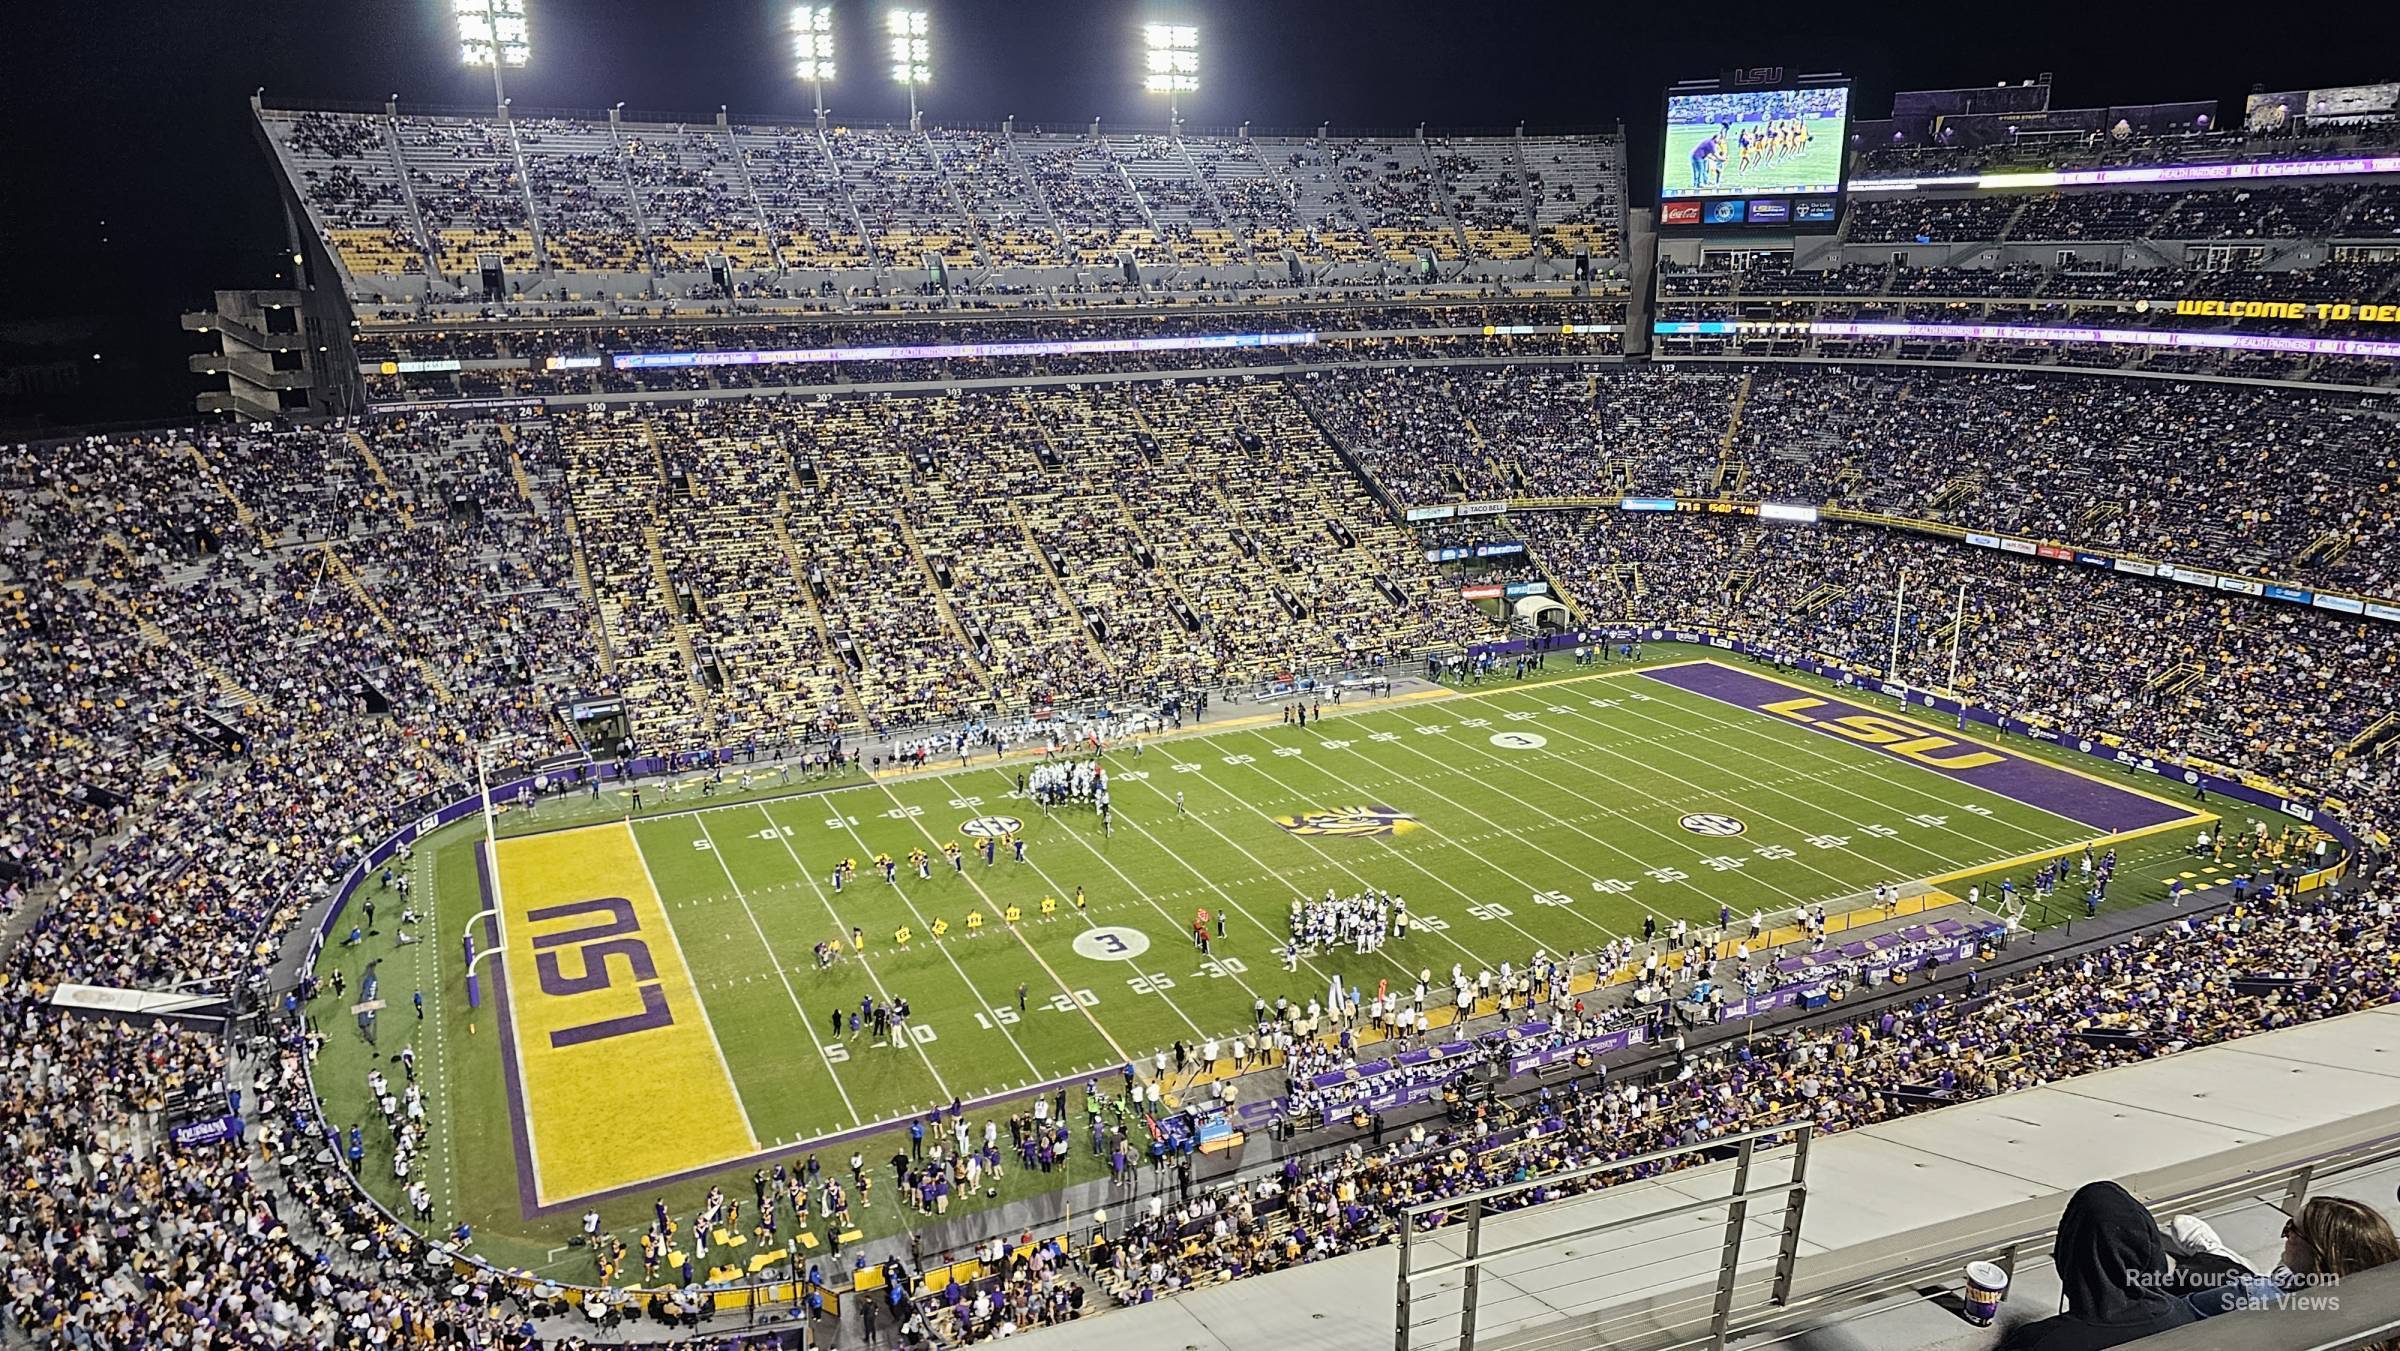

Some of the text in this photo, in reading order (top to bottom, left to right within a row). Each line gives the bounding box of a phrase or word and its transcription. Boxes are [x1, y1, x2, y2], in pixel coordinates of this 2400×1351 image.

[1735, 67, 1783, 85] LSU
[2176, 300, 2400, 322] WELCOME TO DE
[587, 403, 606, 412] 300
[251, 422, 273, 433] 242
[1710, 637, 1733, 649] LSU
[1758, 698, 2007, 769] LSU
[1964, 804, 1994, 817] 5
[2280, 799, 2314, 822] LSU
[416, 813, 440, 838] LSU
[963, 818, 1021, 836] SEC
[1681, 815, 1745, 835] SEC
[1906, 814, 1947, 828] 10
[1857, 824, 1899, 838] 15
[693, 839, 711, 851] 5
[1804, 834, 1849, 849] 20
[1753, 844, 1797, 860] 25
[1700, 856, 1745, 872] 30
[1644, 867, 1690, 883] 35
[1591, 879, 1634, 895] 40
[1532, 891, 1574, 907] 45
[1466, 903, 1513, 921] 50
[1408, 916, 1451, 934] 45
[1093, 934, 1129, 954] 3
[527, 897, 674, 1049] LSU
[1197, 958, 1248, 977] 30
[1126, 972, 1176, 996] 25
[1050, 989, 1100, 1013] 20
[974, 1005, 1021, 1030] 15
[824, 1043, 850, 1063] 5
